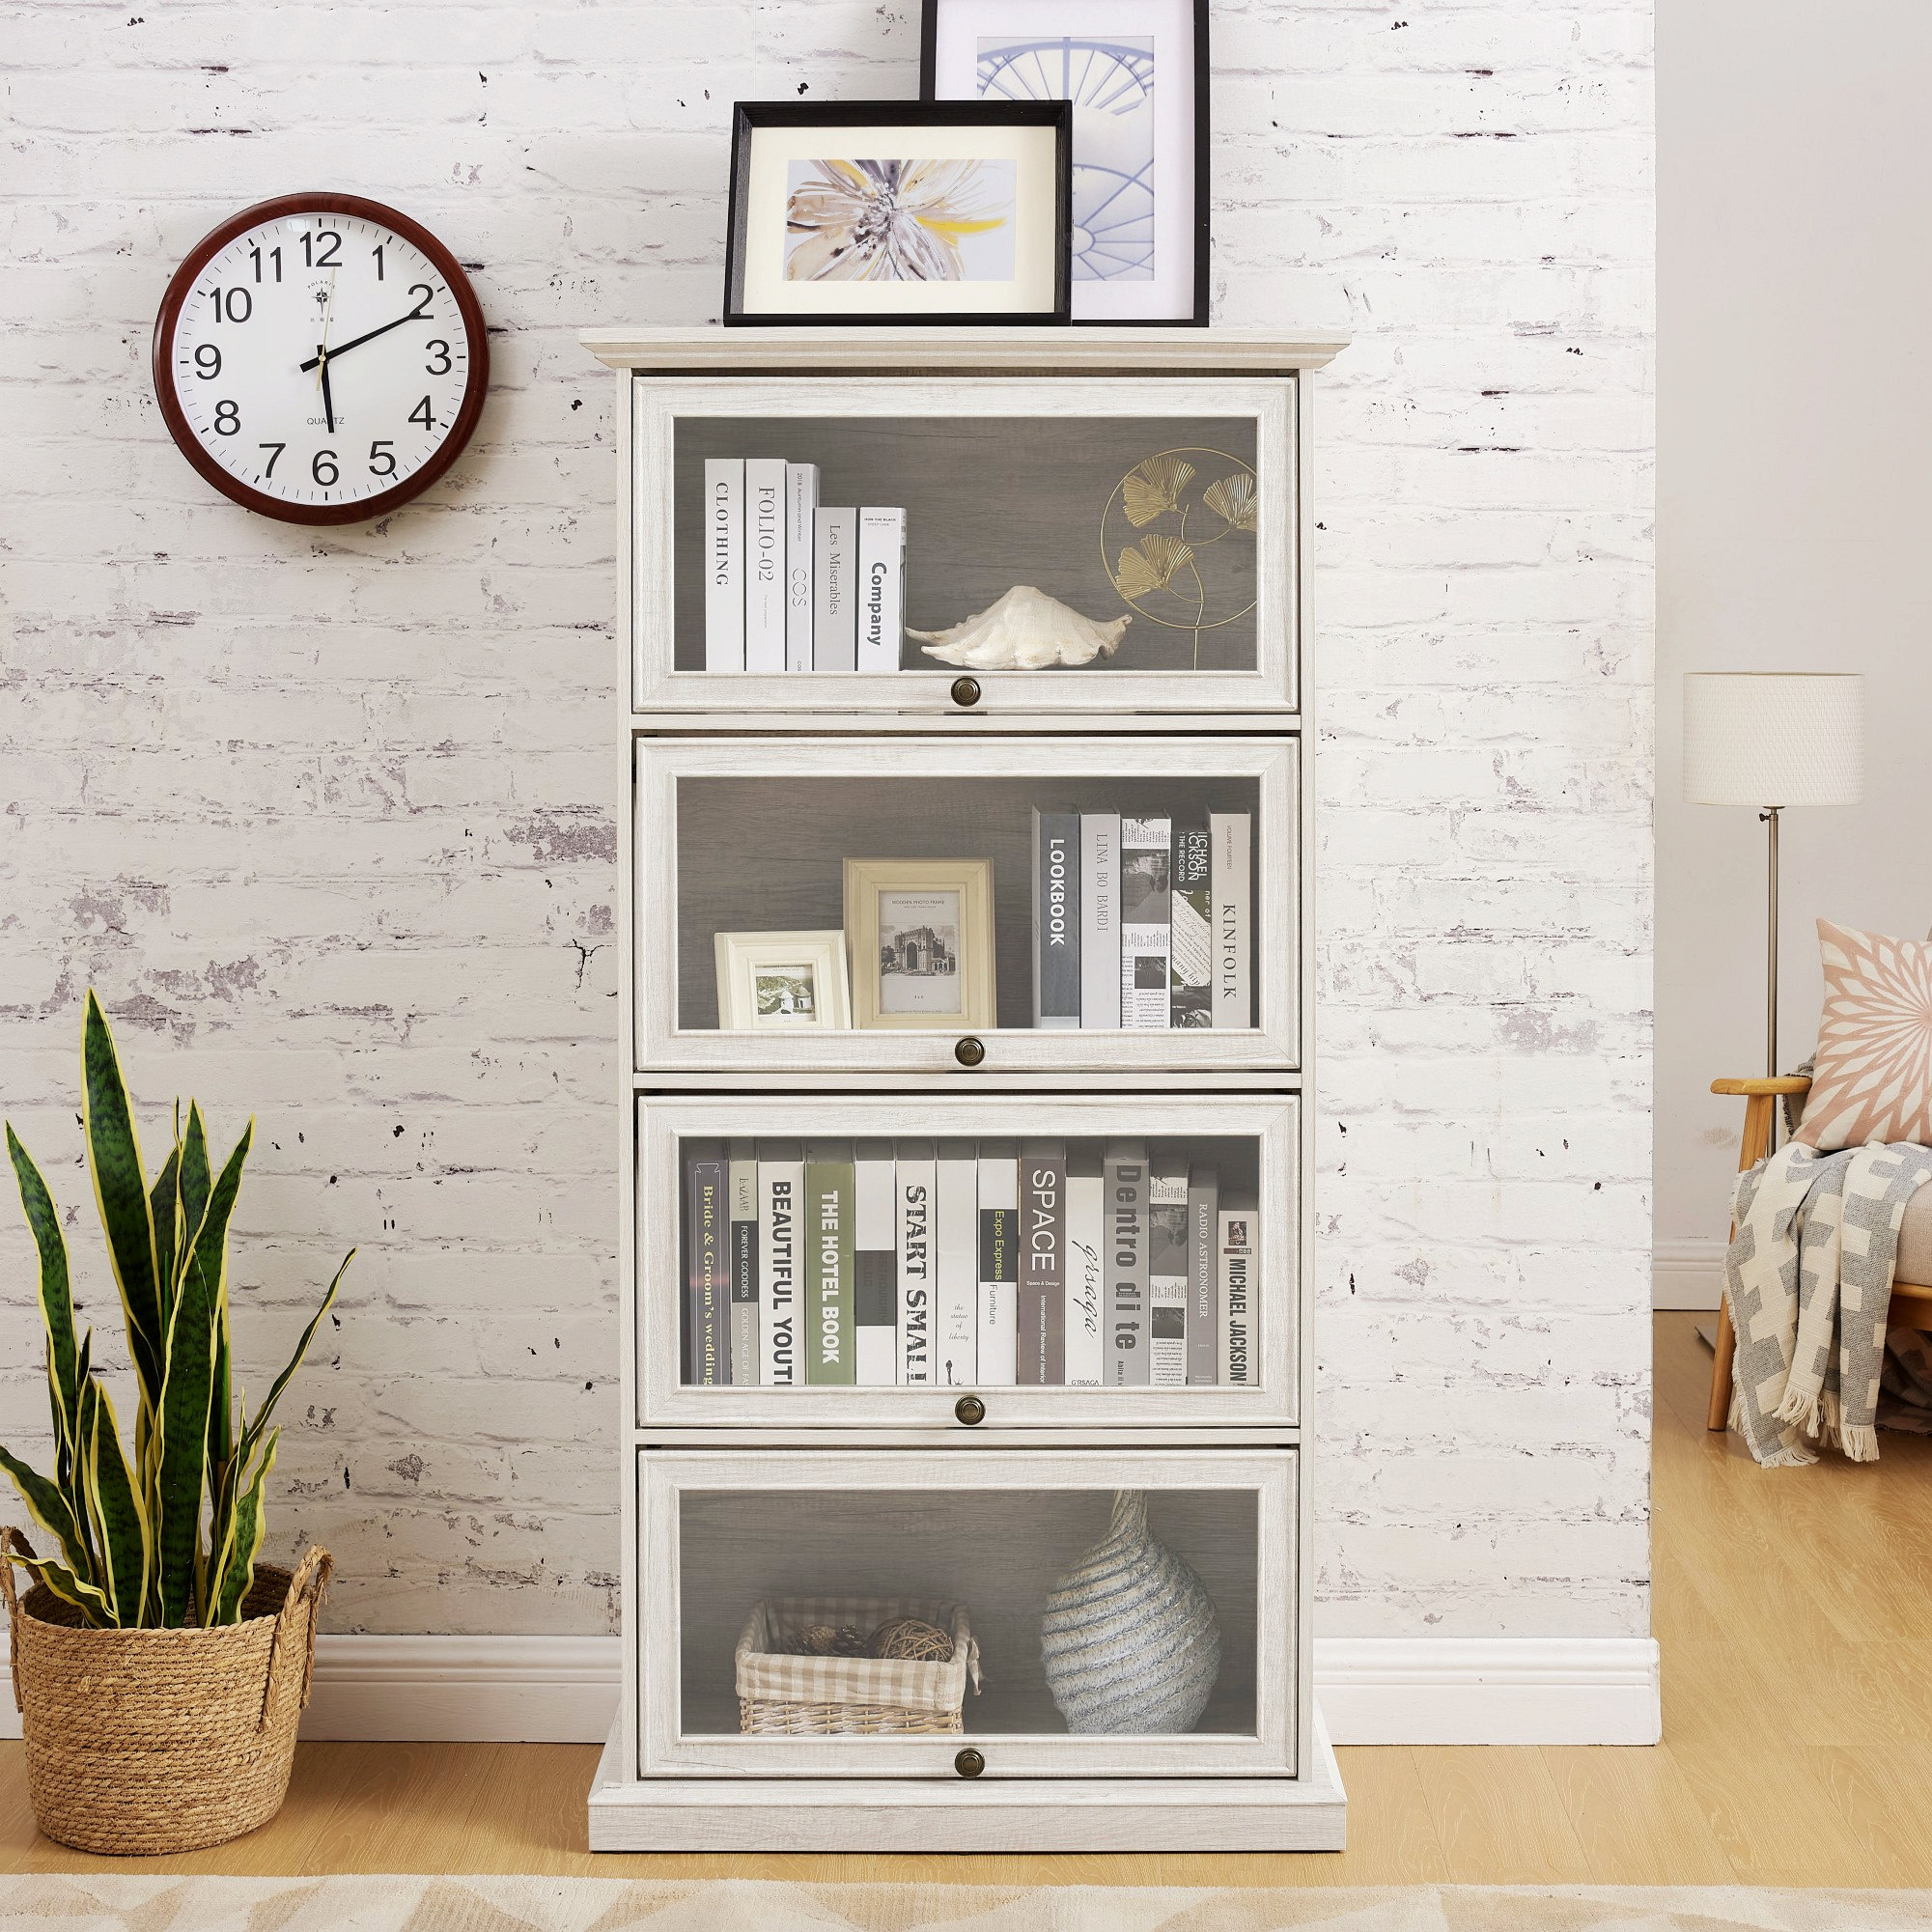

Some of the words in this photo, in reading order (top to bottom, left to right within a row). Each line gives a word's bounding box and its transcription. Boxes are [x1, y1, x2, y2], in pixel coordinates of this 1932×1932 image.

[249, 246, 282, 283] 11
[299, 231, 343, 267] 12
[372, 244, 384, 281] 1
[210, 287, 252, 323] 10
[407, 284, 434, 320] 2
[194, 344, 222, 380] 9
[425, 339, 452, 376] 3
[213, 399, 241, 436] 8
[306, 416, 345, 425] QUATZ
[407, 395, 436, 431] 4
[259, 442, 286, 478] 7
[312, 450, 340, 487] 6
[368, 440, 397, 476] 5
[715, 482, 729, 586] CLOTHING
[758, 487, 775, 581] FOLIO-02
[829, 524, 841, 546] Les
[792, 568, 807, 607] COS
[829, 552, 841, 615] Miserables
[866, 562, 887, 646] Company
[1096, 833, 1108, 864] LINA
[1050, 838, 1065, 946] LOOKBOOK
[1096, 876, 1108, 887] BO
[1096, 895, 1108, 933] BARDI
[1204, 909, 1211, 917] of
[1222, 903, 1237, 999] KINFOLK
[703, 1186, 714, 1228] Bride
[821, 1190, 839, 1231] THE
[994, 1211, 1004, 1237] Expo
[1031, 1169, 1056, 1272] SPACE
[1115, 1165, 1141, 1268] Dentro
[1199, 1203, 1208, 1239] RADIO
[704, 1232, 714, 1246] &
[771, 1181, 793, 1309] BEAUTIFUL
[906, 1185, 927, 1279] START
[821, 1236, 839, 1302] HOTEL
[994, 1240, 1004, 1280] Express
[703, 1252, 714, 1319] Groom's
[741, 1261, 749, 1298] GODDESS
[1115, 1282, 1141, 1311] di
[1198, 1243, 1208, 1318] ASTRONOMER
[1228, 1258, 1246, 1316] MICHAEL
[741, 1307, 749, 1341] GOLDEN
[989, 1285, 998, 1326] Furniture
[822, 1306, 840, 1364] BOOK
[948, 1332, 969, 1342] liberty
[955, 1321, 963, 1330] of
[1115, 1322, 1140, 1350] te
[703, 1324, 714, 1385] wedding
[742, 1360, 749, 1371] OF
[773, 1316, 793, 1385] YOUT
[1228, 1320, 1247, 1382] JACKSON
